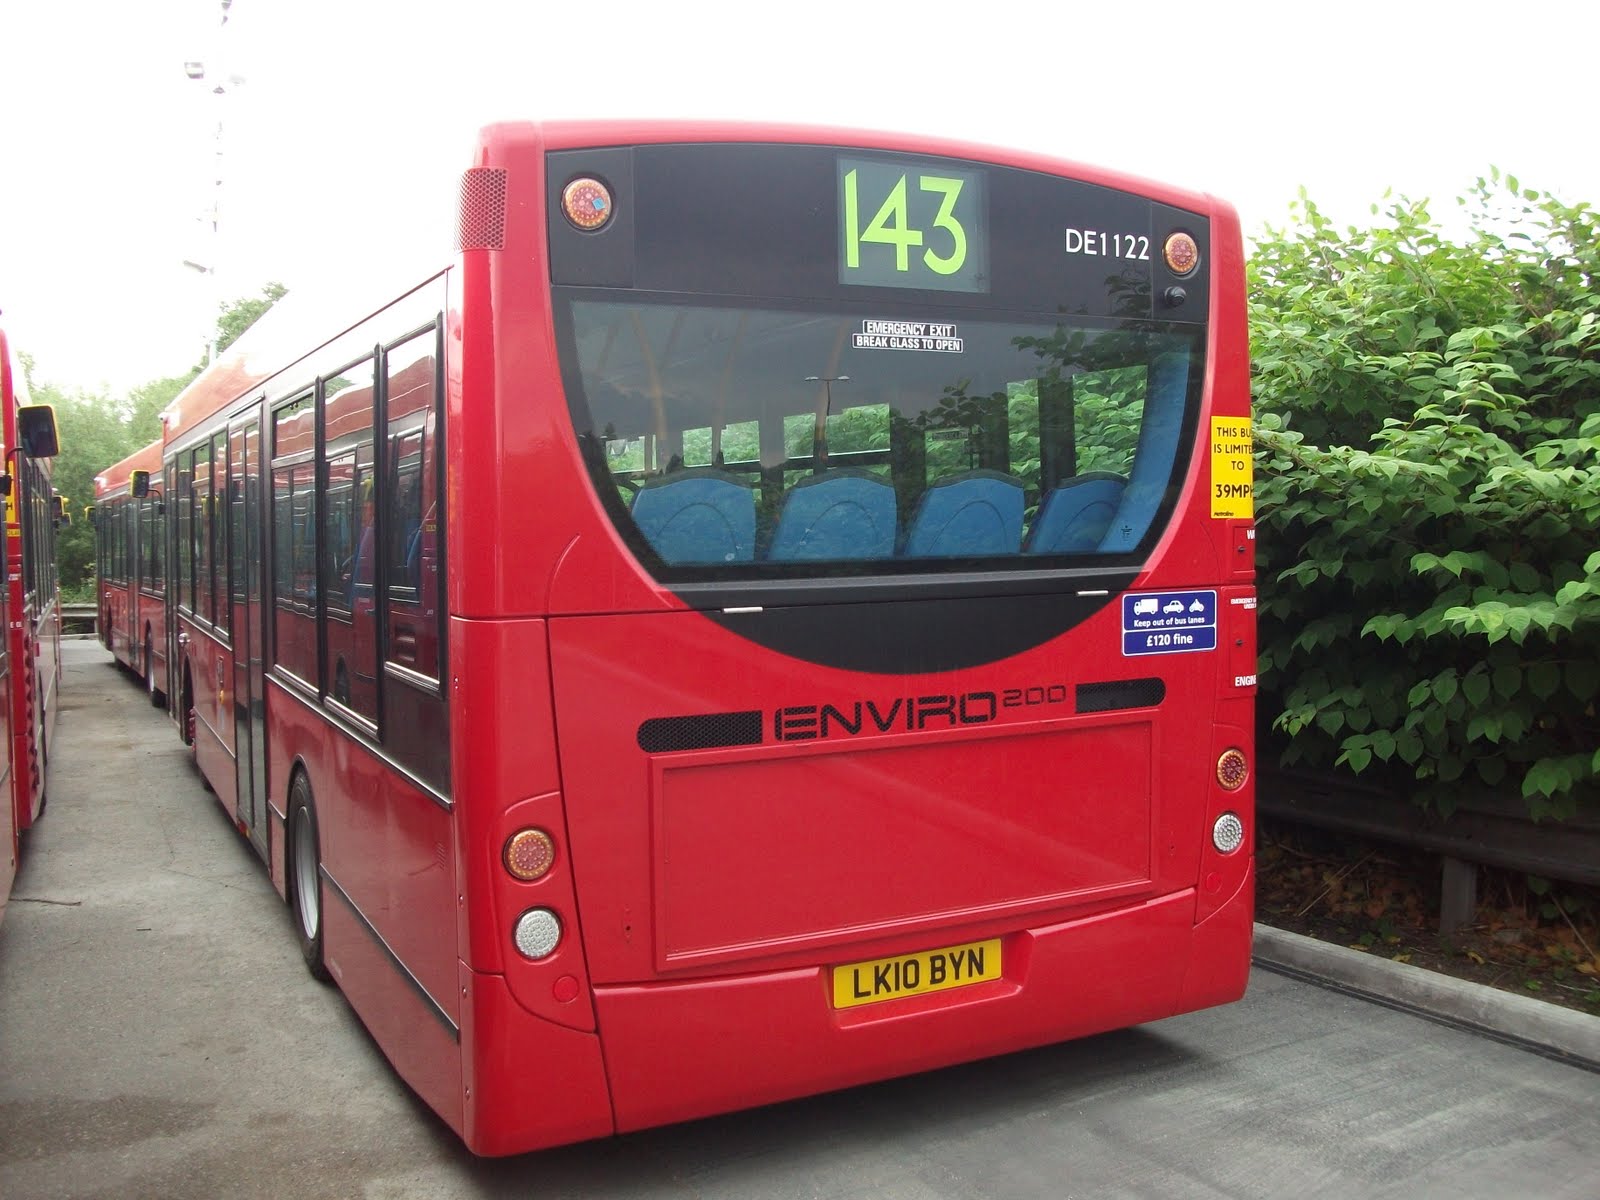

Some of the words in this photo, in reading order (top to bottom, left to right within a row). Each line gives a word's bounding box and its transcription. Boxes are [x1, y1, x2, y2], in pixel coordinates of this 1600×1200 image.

[844, 168, 967, 275] 143
[1065, 228, 1150, 261] DE1122
[866, 321, 926, 336] EMERGENCY
[929, 325, 952, 337] EXIT
[856, 336, 888, 347] BREAK
[890, 337, 919, 349] GLASS
[921, 339, 934, 350] TO
[936, 340, 960, 351] OPEN
[1216, 427, 1238, 437] THIS
[1240, 427, 1251, 438] BU
[1213, 444, 1222, 454] IS
[1225, 444, 1252, 454] LIMITE
[1231, 460, 1245, 470] TO
[1133, 619, 1151, 628] Keep
[1152, 618, 1164, 626] out
[1165, 617, 1174, 625] of
[1174, 617, 1187, 625] bus
[1188, 616, 1205, 624] lanes
[1146, 633, 1171, 647] £120
[1173, 633, 1193, 645] fine
[774, 691, 997, 741] ENVIRO
[1002, 685, 1067, 708] 200
[853, 958, 920, 999] LK10
[929, 947, 984, 985] BYN
